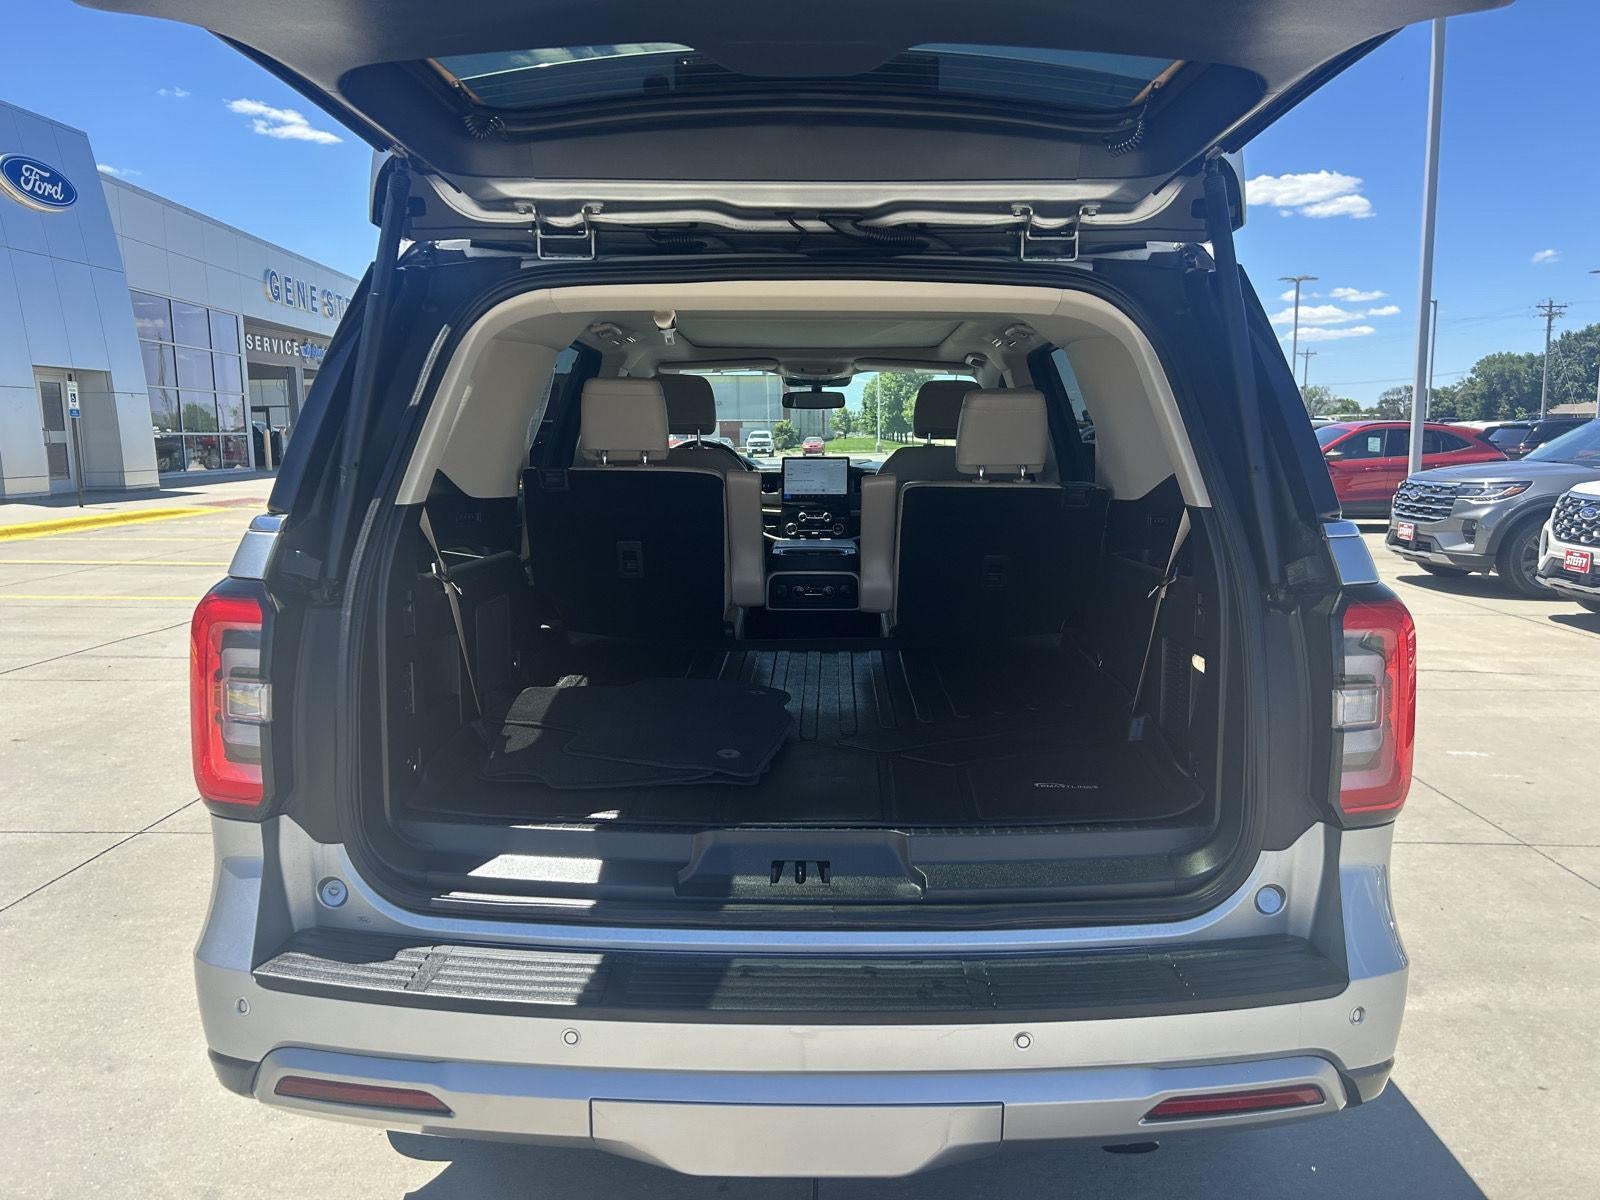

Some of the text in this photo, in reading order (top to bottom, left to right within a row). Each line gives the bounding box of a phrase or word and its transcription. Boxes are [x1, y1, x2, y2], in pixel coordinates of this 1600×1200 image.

[20, 164, 64, 201] Ford
[265, 269, 318, 313] GENE
[246, 334, 299, 357] SERVICE
[1566, 555, 1588, 568] STEFFY
